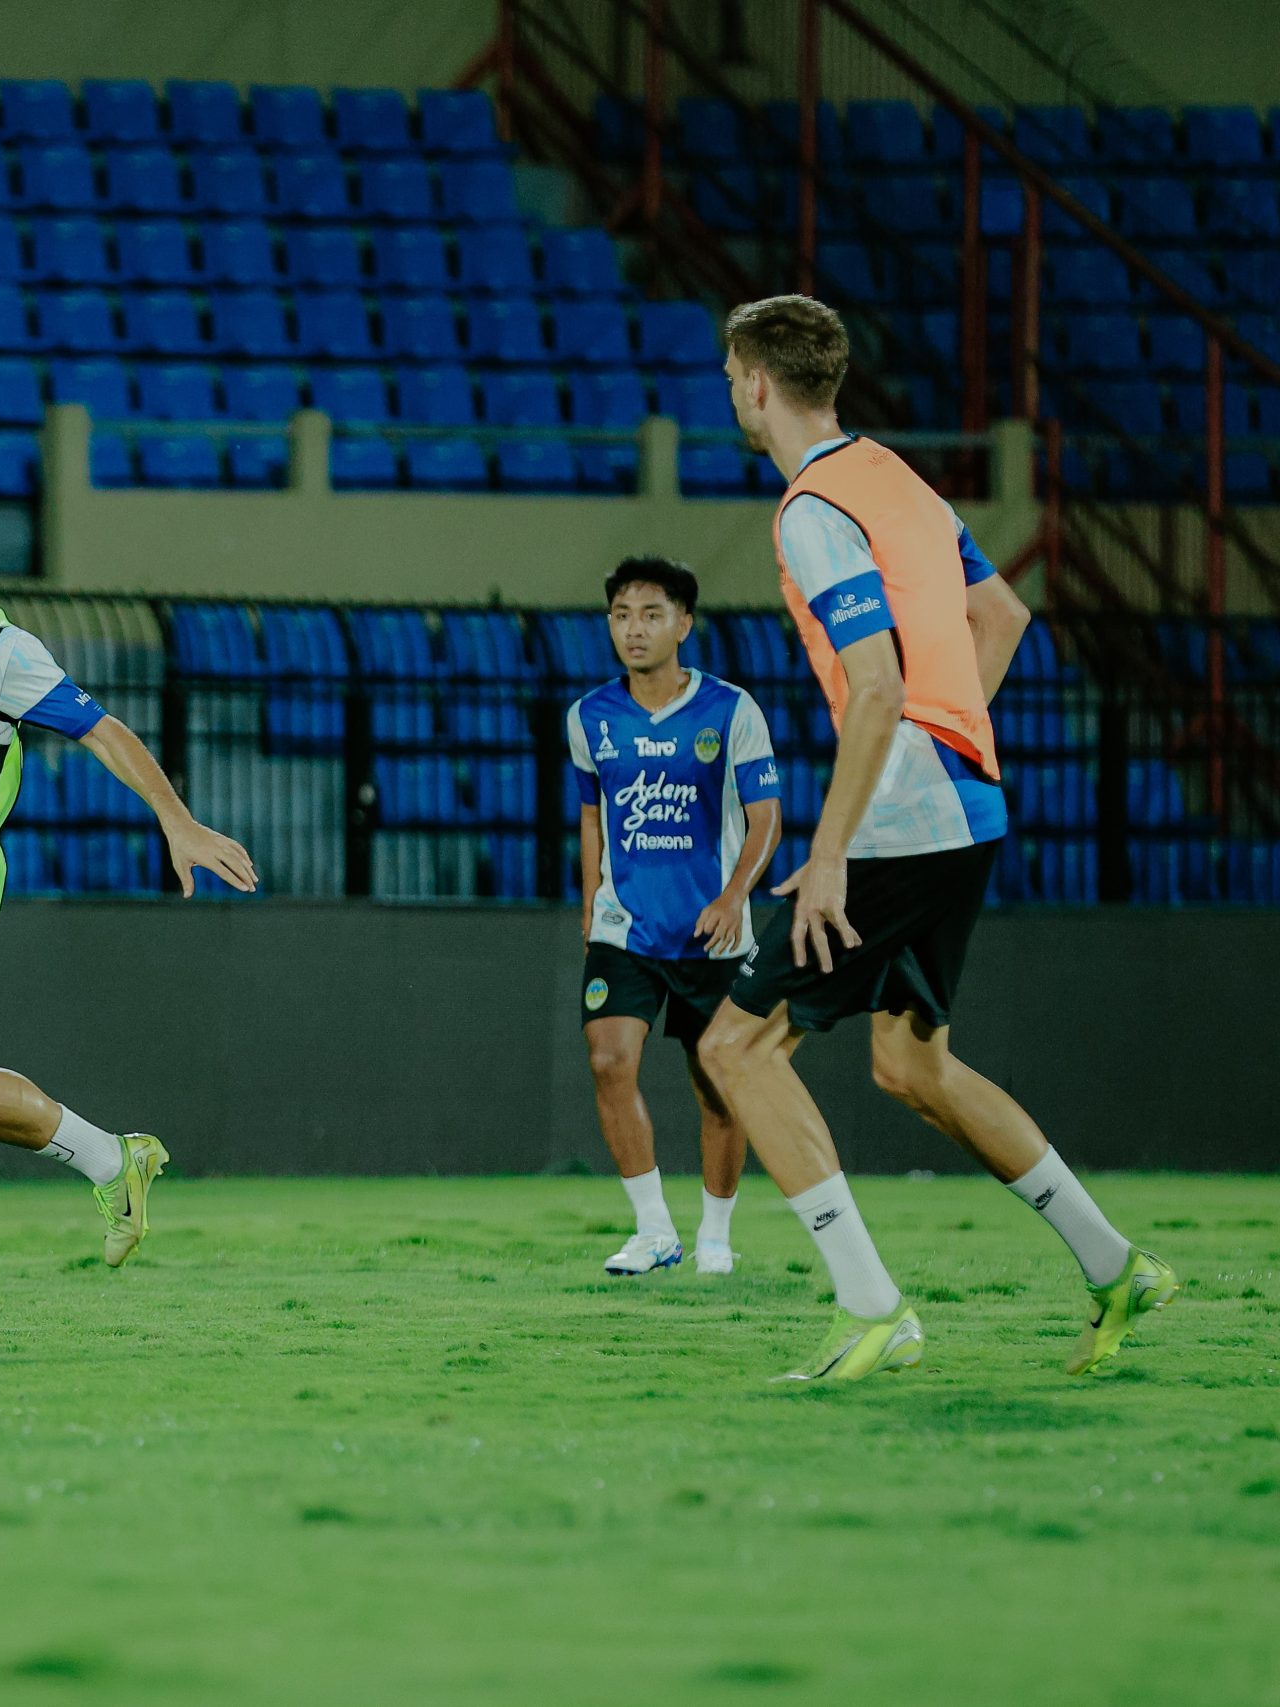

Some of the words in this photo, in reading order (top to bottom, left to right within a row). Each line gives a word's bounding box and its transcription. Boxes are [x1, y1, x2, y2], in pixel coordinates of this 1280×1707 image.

[831, 596, 881, 626] Minerale
[839, 593, 857, 608] Le
[633, 736, 676, 757] Taro
[614, 769, 698, 807] Adem
[623, 797, 688, 832] Sari
[636, 832, 693, 850] Rexona
[815, 1208, 839, 1225] NIKE
